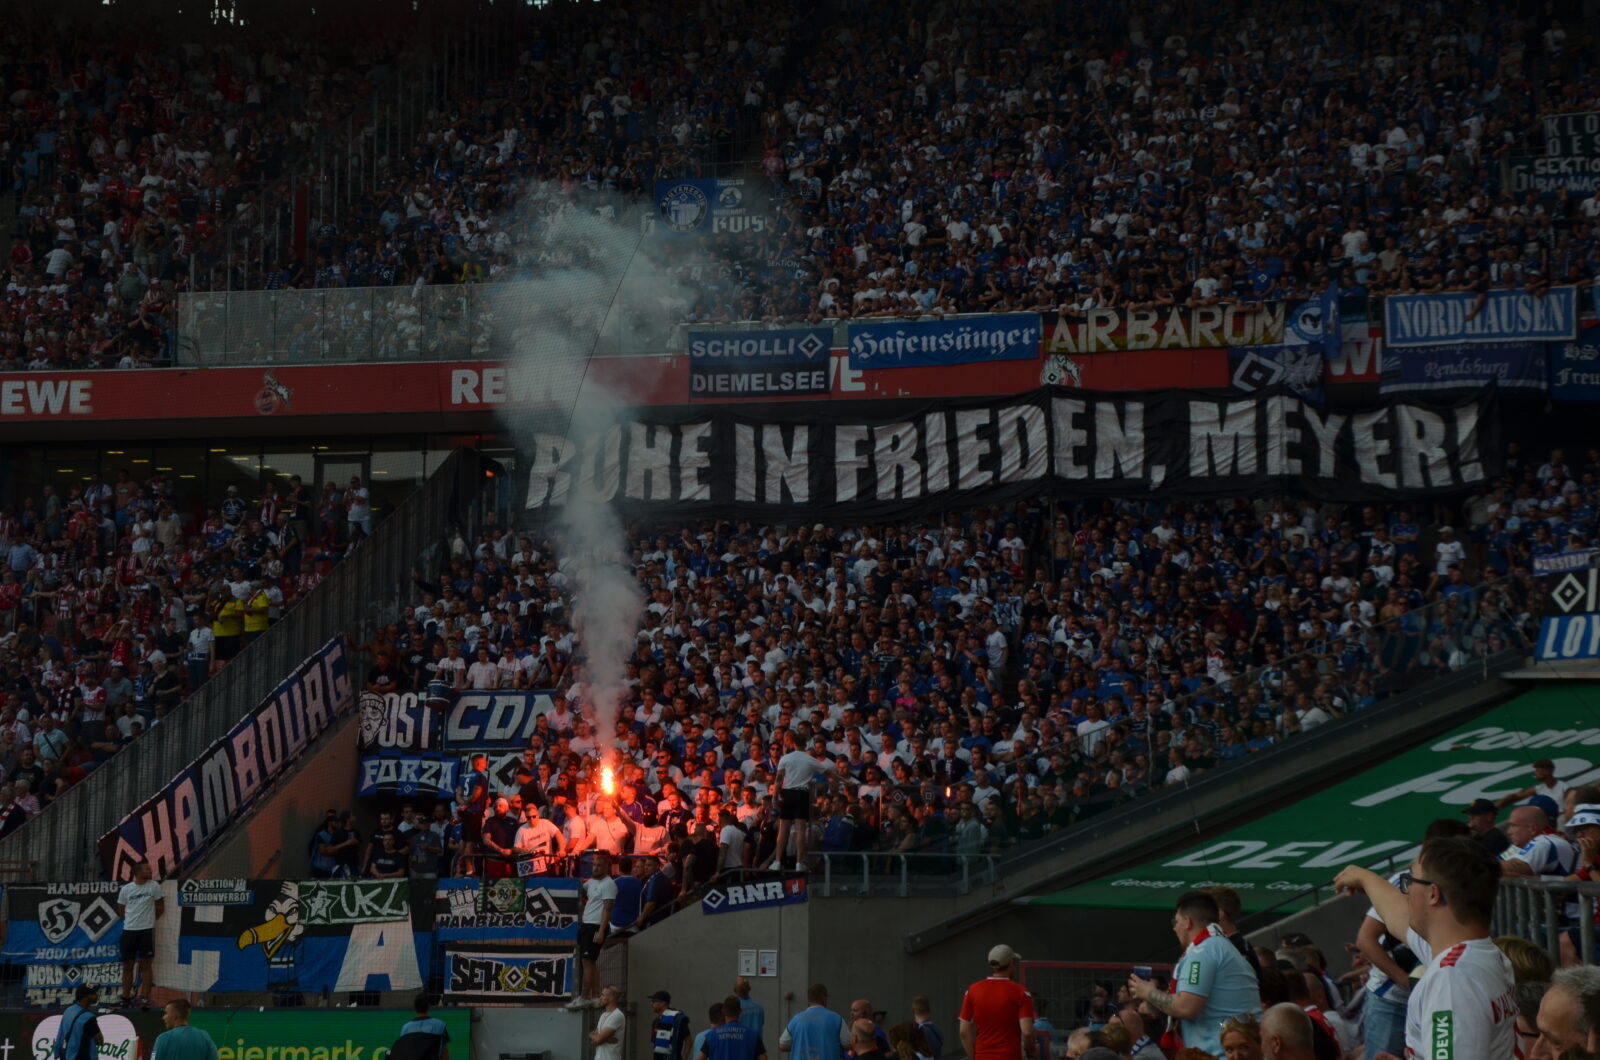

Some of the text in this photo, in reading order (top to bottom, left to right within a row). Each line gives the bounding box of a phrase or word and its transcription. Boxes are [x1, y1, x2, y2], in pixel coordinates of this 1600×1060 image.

[692, 338, 796, 358] SCHOLLI
[1424, 357, 1509, 379] Rendsburg
[1554, 367, 1600, 387] Freu
[693, 371, 825, 392] DIEMELSEE
[525, 395, 1486, 509] RUHE IN FRIEDEN, MEYER!
[48, 881, 118, 895] HAMBURG
[199, 880, 234, 889] SEKTION
[727, 882, 786, 906] RNR
[183, 892, 250, 903] STADIONVERBOT
[439, 911, 574, 929] HAMBURG SÜD
[35, 945, 118, 960] HOOLIGANS
[28, 964, 63, 986] NORD
[1190, 962, 1200, 985] DEVK
[1435, 1015, 1451, 1060] DEVK
